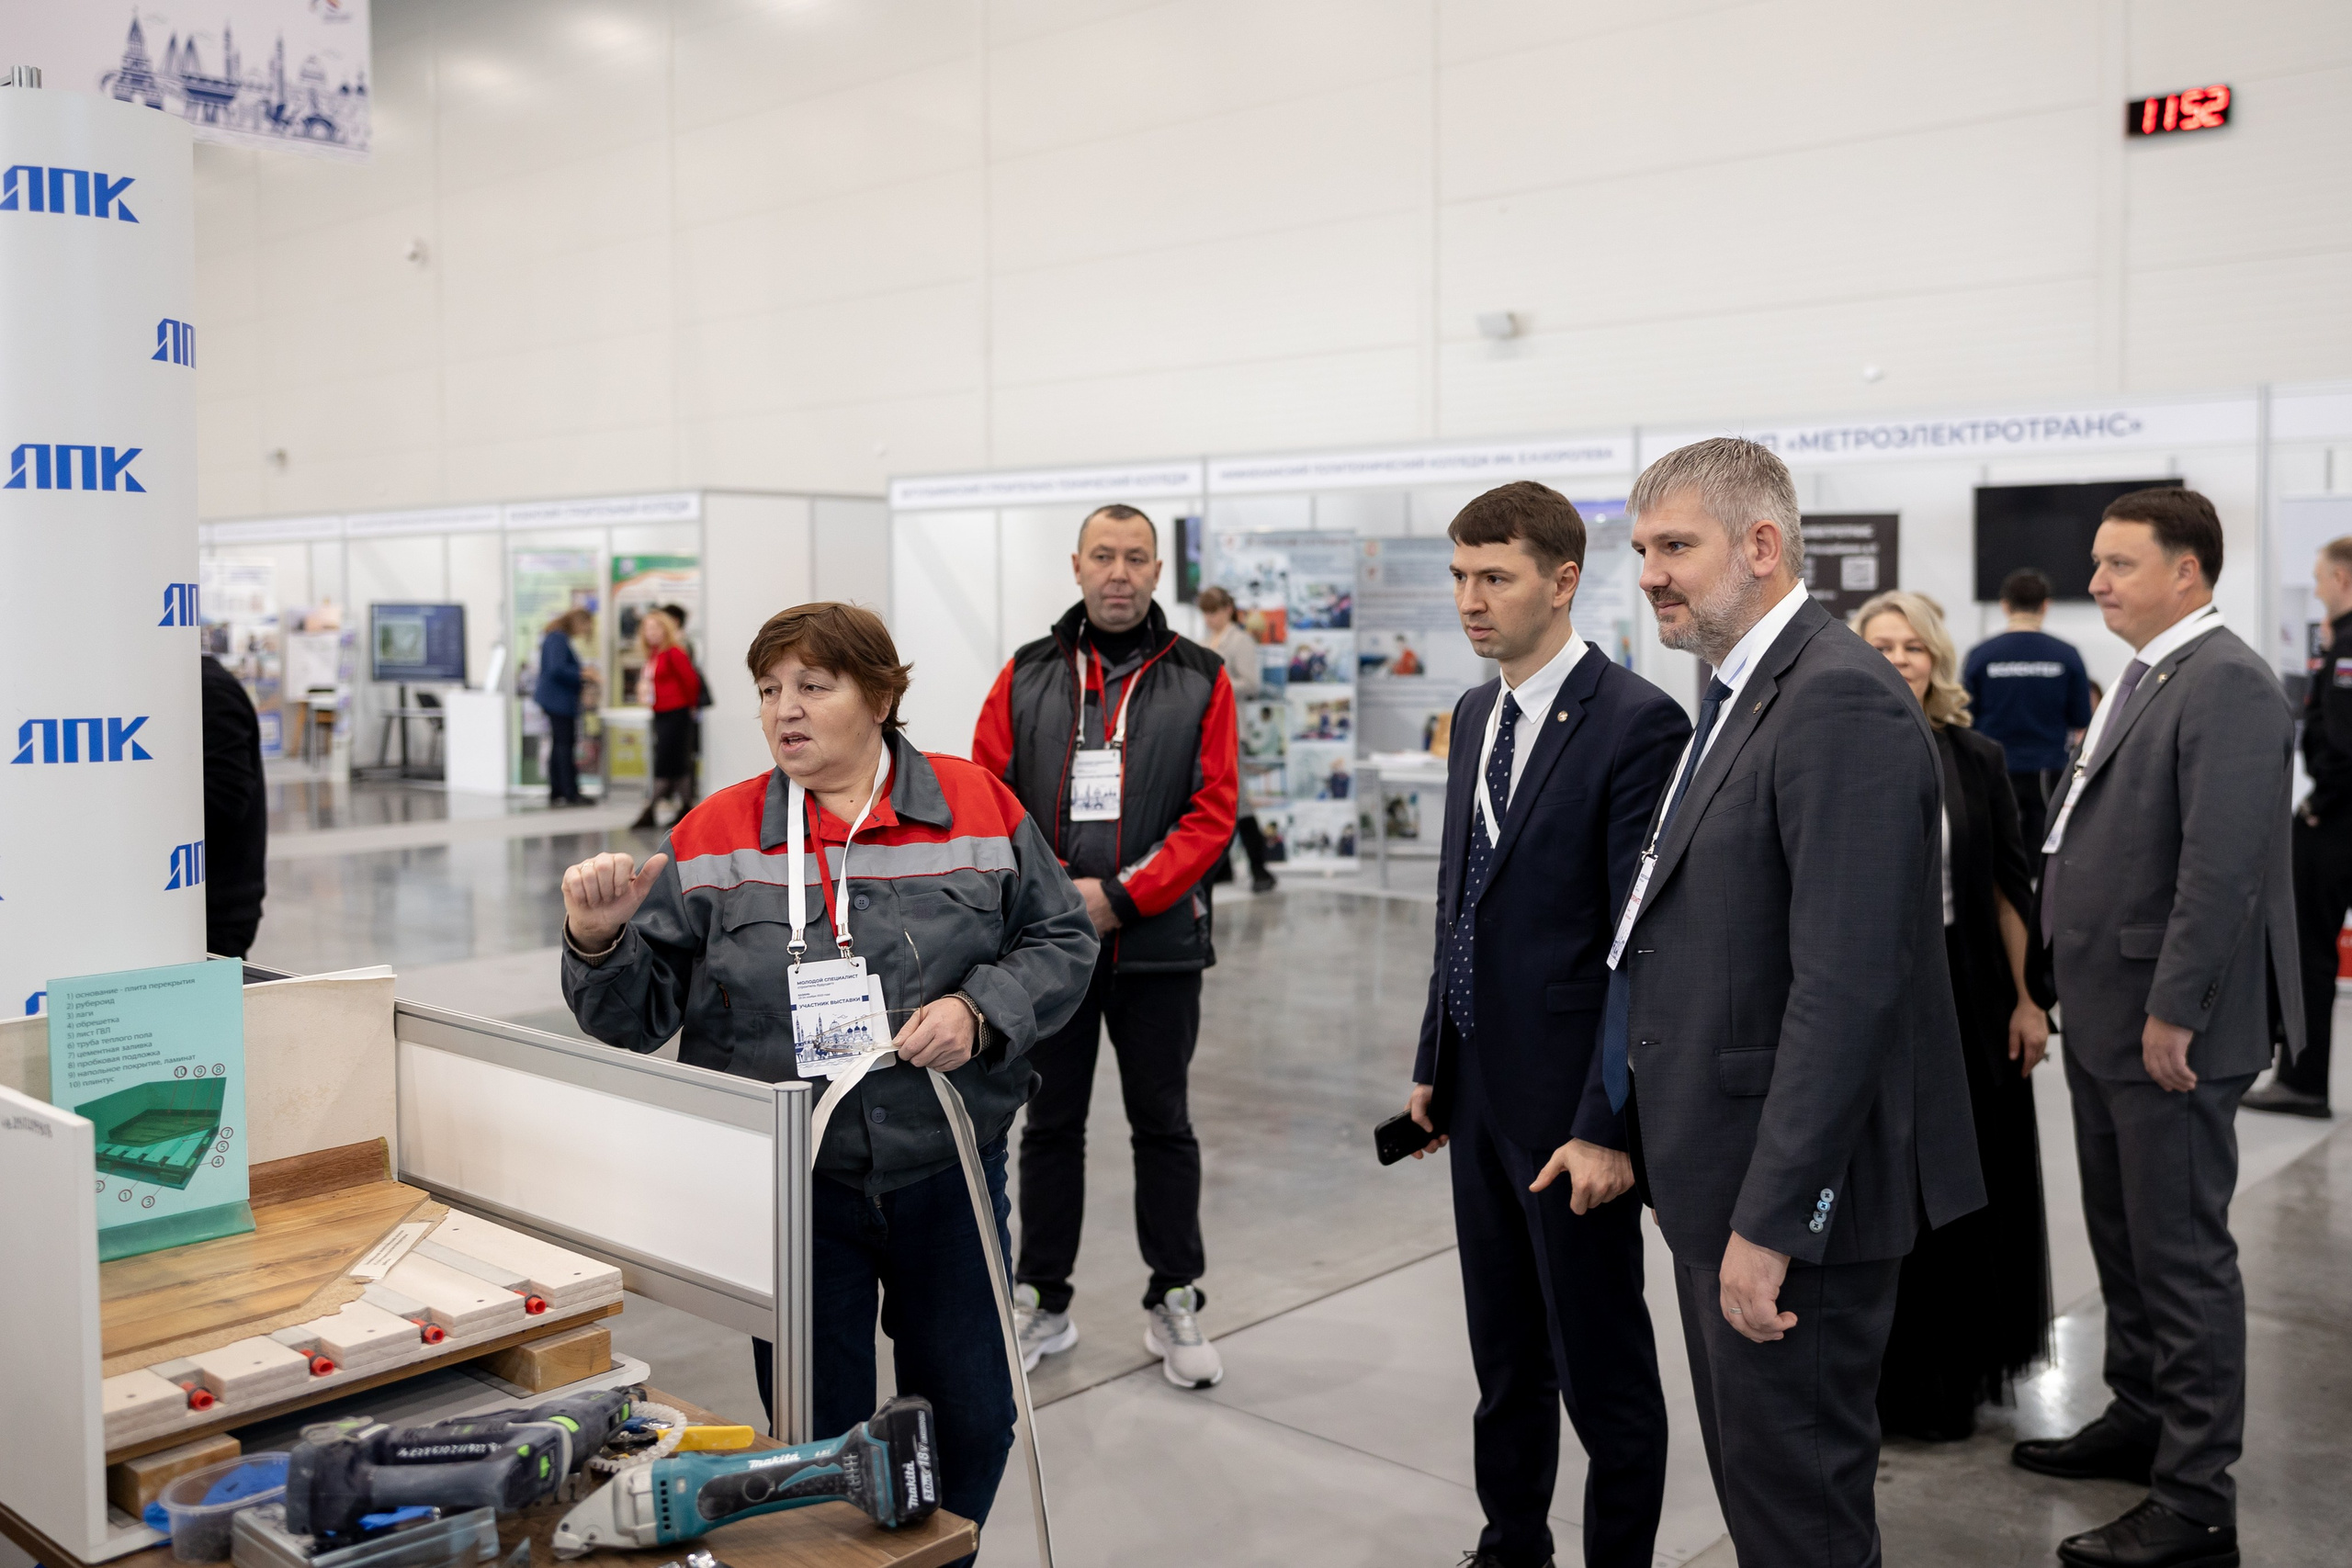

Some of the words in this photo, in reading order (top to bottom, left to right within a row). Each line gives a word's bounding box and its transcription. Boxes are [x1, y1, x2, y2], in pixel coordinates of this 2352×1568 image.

[0, 164, 140, 224] ЛПК
[151, 318, 197, 370] ЛП
[1786, 411, 2143, 455] «МЕТРОЭЛЕКТРОТРАНС»
[3, 443, 147, 493] ЛПК
[157, 582, 200, 626] ЛП
[9, 716, 154, 764] ЛПК
[164, 839, 206, 892] ЛП
[75, 987, 119, 998] основание
[124, 984, 147, 992] плита
[149, 978, 196, 990] перекрытия
[797, 977, 823, 986] МОЛОДОЙ
[824, 974, 858, 983] СПЕЦИАЛИСТ
[75, 998, 115, 1010] рубероид
[799, 1000, 829, 1009] УЧАСТНИК
[830, 997, 861, 1005] ВЫСТАВКИ
[75, 1010, 94, 1019] лаги
[75, 1017, 119, 1028] обрешетка
[76, 1030, 95, 1038] лист
[96, 1027, 111, 1035] ГВЛ
[76, 1038, 99, 1048] труба
[101, 1035, 132, 1044] теплого
[134, 1032, 153, 1040] пола
[76, 1047, 119, 1058] цементная
[121, 1042, 153, 1052] заливка
[77, 1055, 120, 1068] пробковая
[122, 1050, 161, 1062] подложка
[77, 1066, 121, 1077] напольное
[164, 1054, 196, 1065] ламинат
[82, 1077, 115, 1087] плинтус
